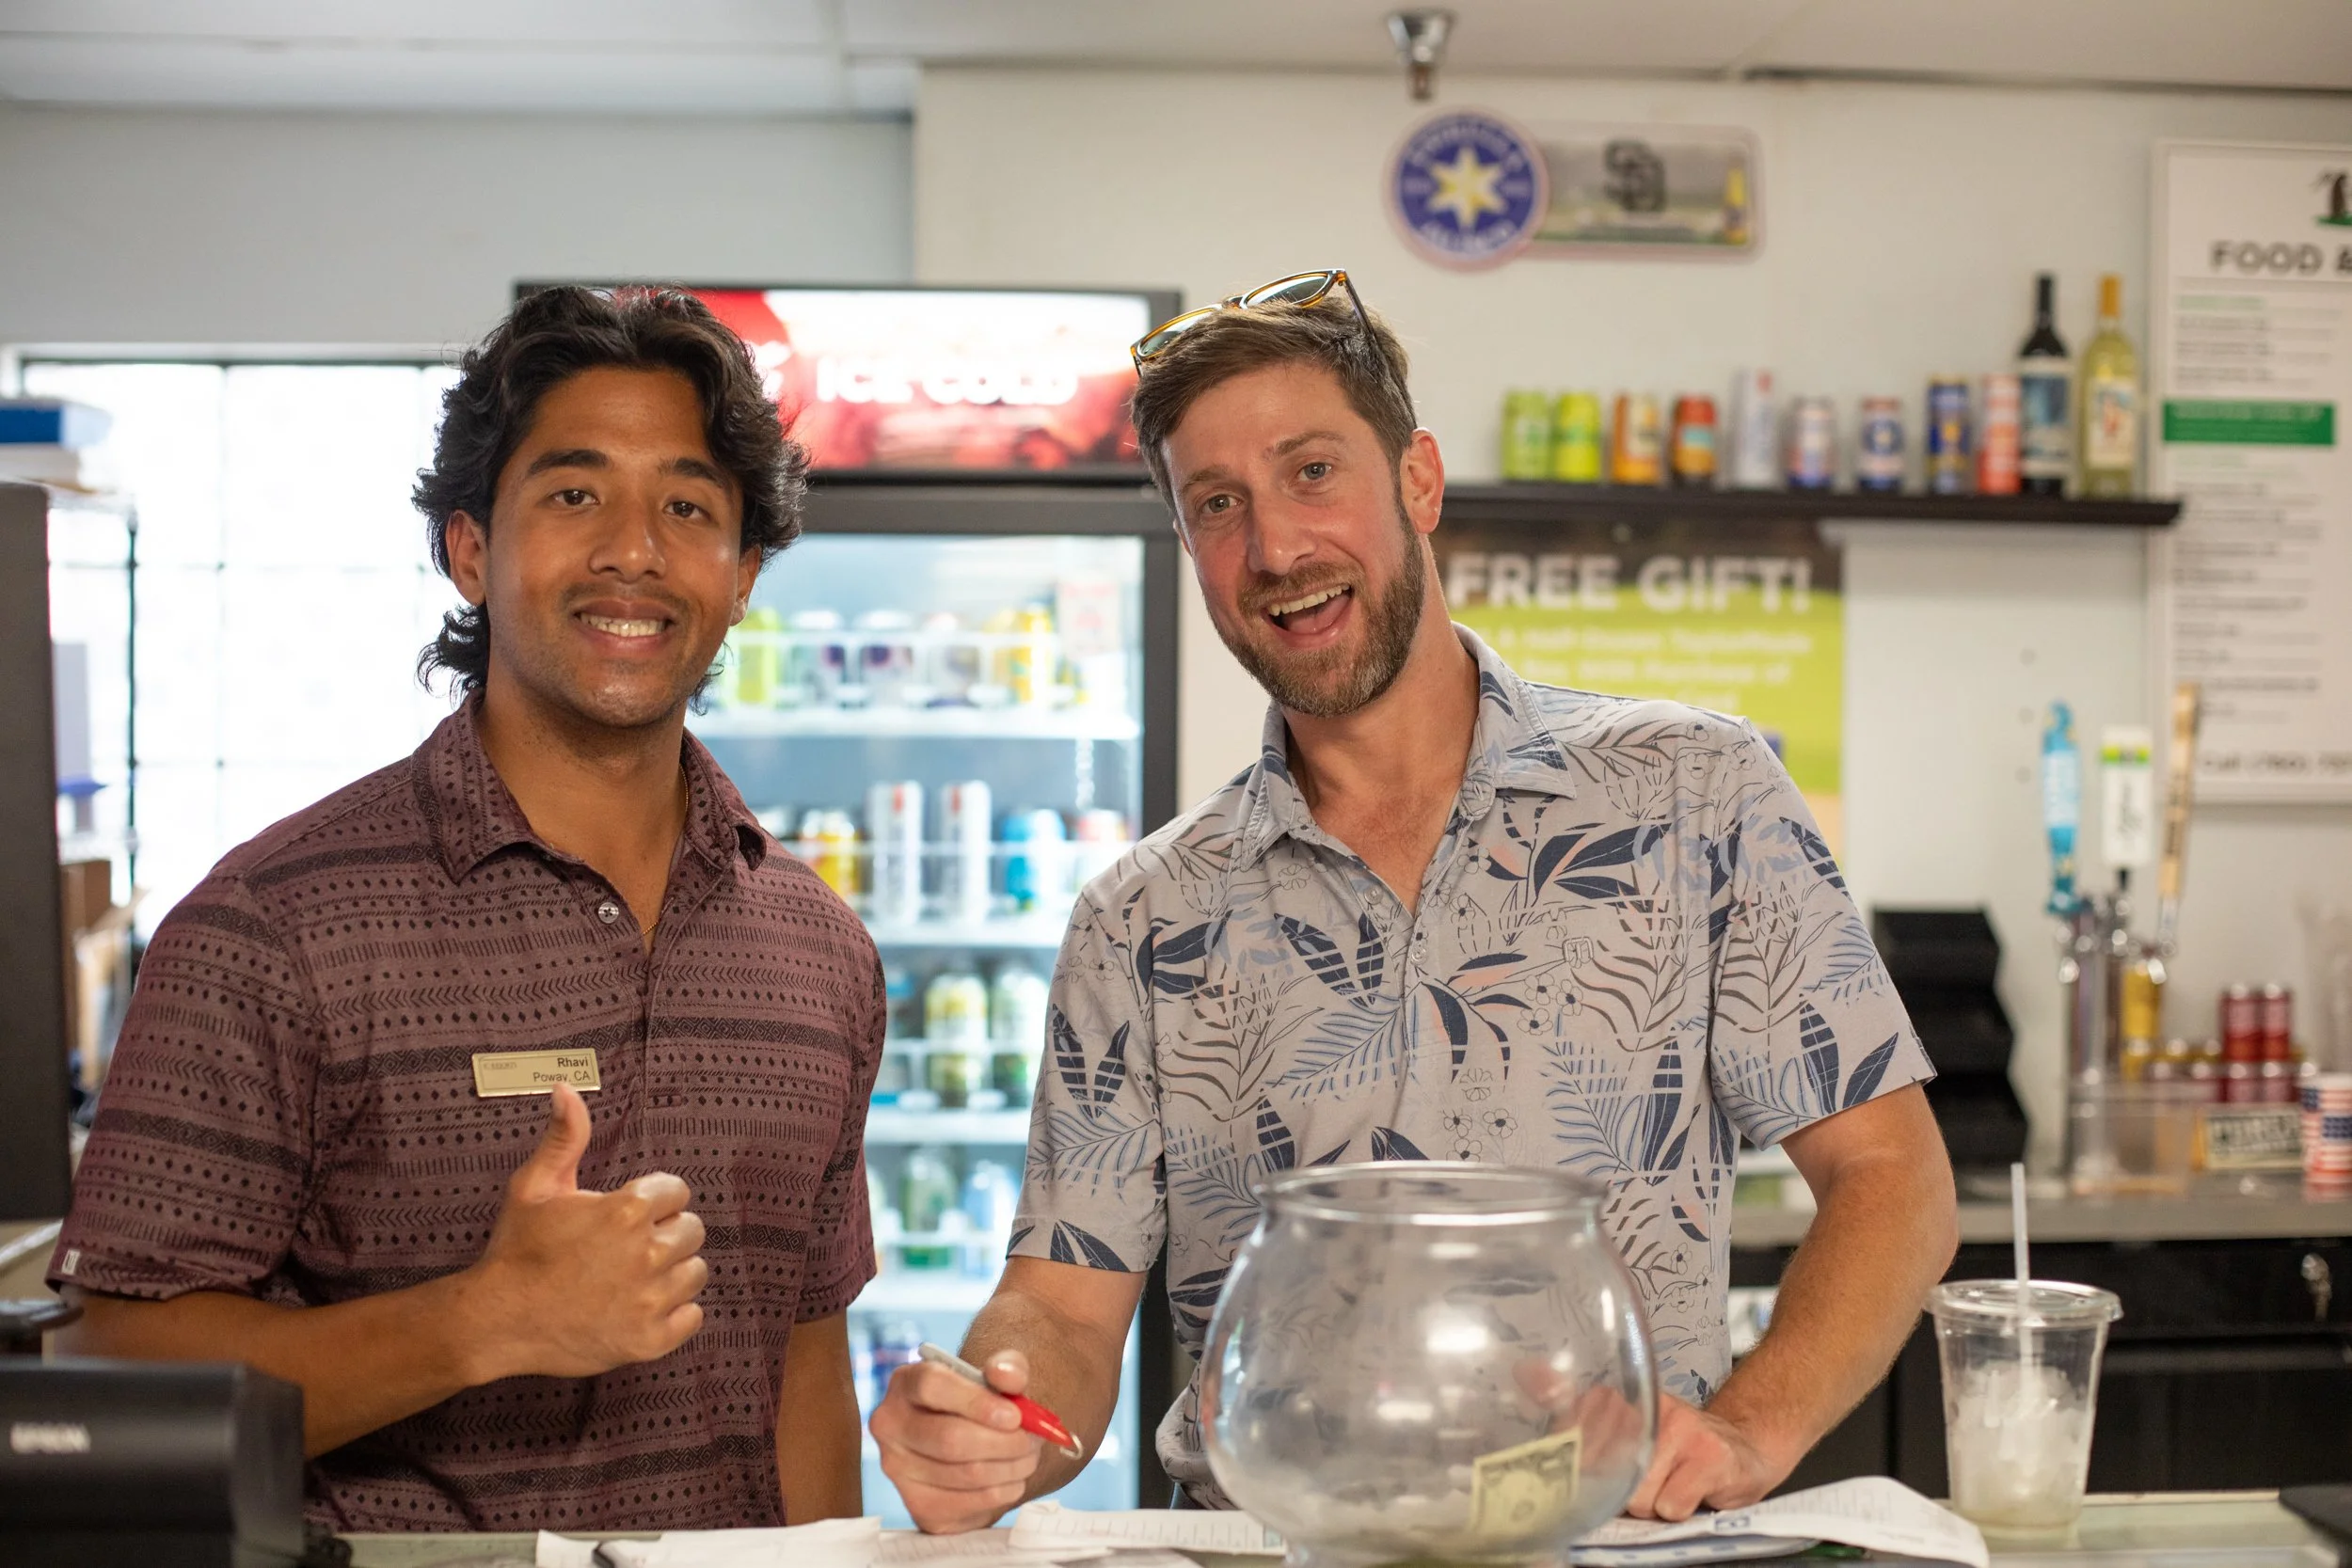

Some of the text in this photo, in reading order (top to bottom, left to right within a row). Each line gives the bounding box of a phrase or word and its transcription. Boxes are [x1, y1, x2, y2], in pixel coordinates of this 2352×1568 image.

[2211, 242, 2324, 276] FOOD
[1449, 554, 1812, 613] FREE GIFT!
[558, 1057, 588, 1068] Rhavi
[574, 1070, 591, 1081] CA
